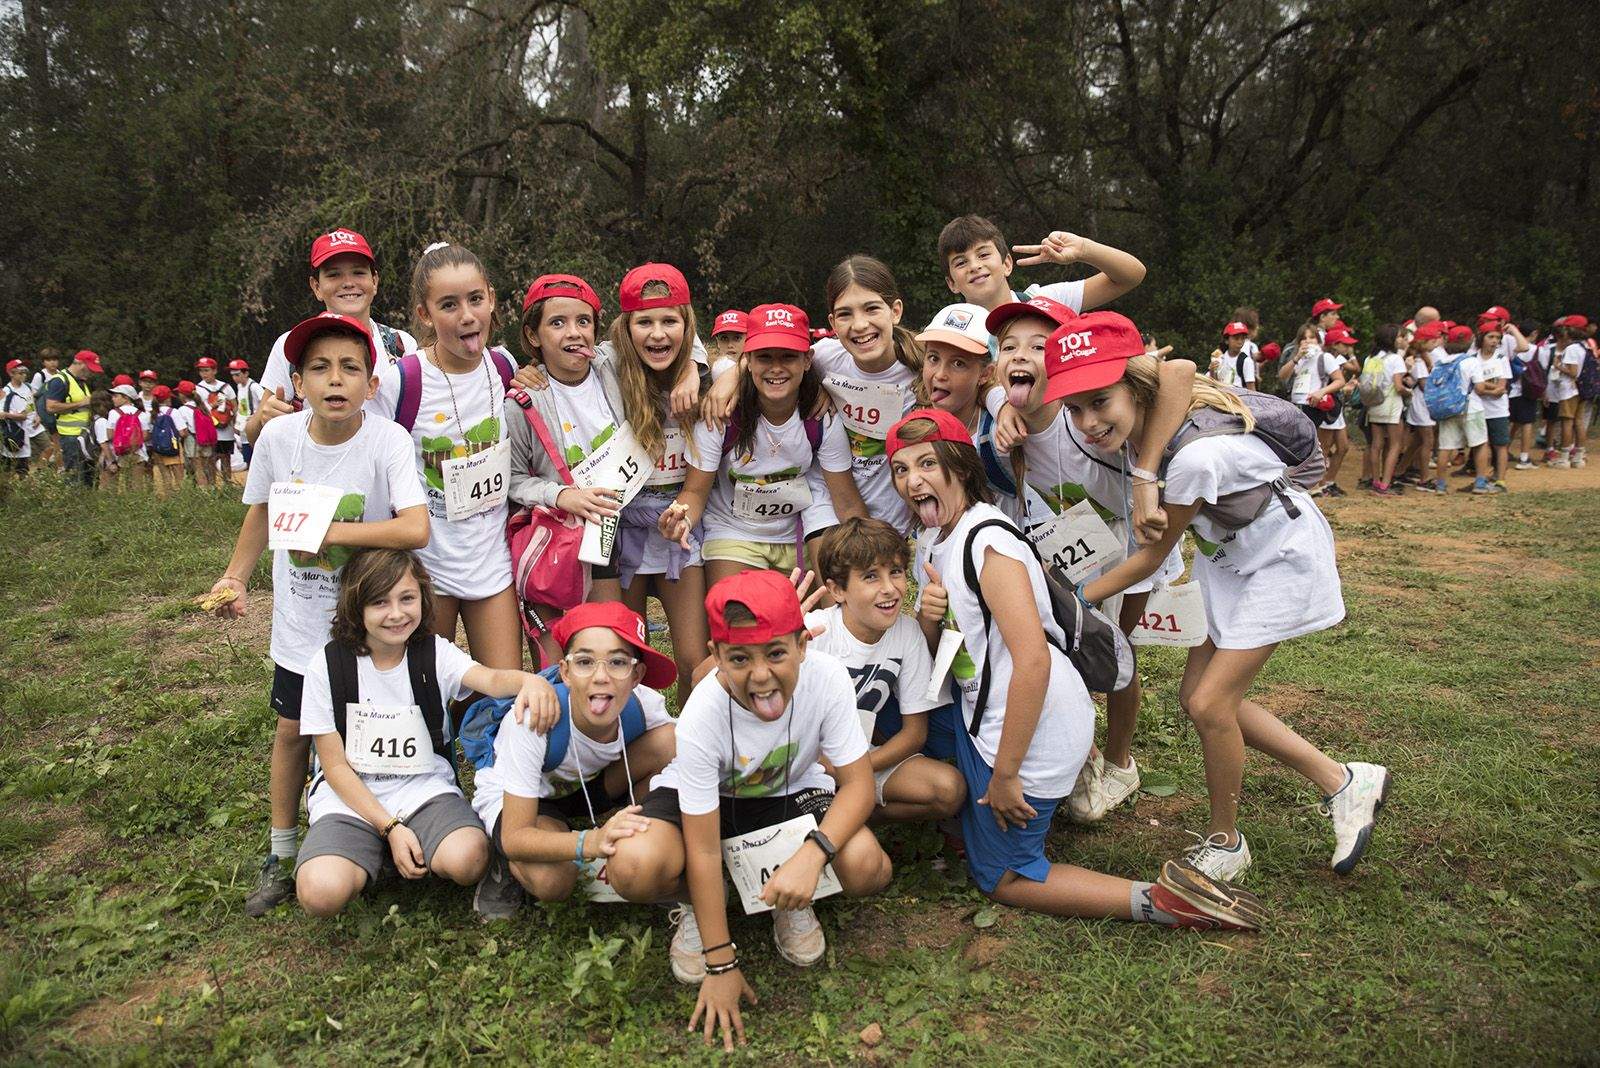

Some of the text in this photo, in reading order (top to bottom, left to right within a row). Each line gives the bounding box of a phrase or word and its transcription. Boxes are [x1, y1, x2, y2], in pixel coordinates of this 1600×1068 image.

[328, 231, 355, 242] TOT
[721, 312, 738, 321] TOT
[765, 308, 793, 322] TOT
[1057, 331, 1093, 354] TOT
[842, 403, 881, 425] 419
[470, 472, 504, 500] 419
[755, 503, 794, 516] 420
[273, 512, 310, 532] 417
[1053, 538, 1096, 571] 421
[1137, 613, 1182, 633] 421
[370, 737, 417, 758] 416
